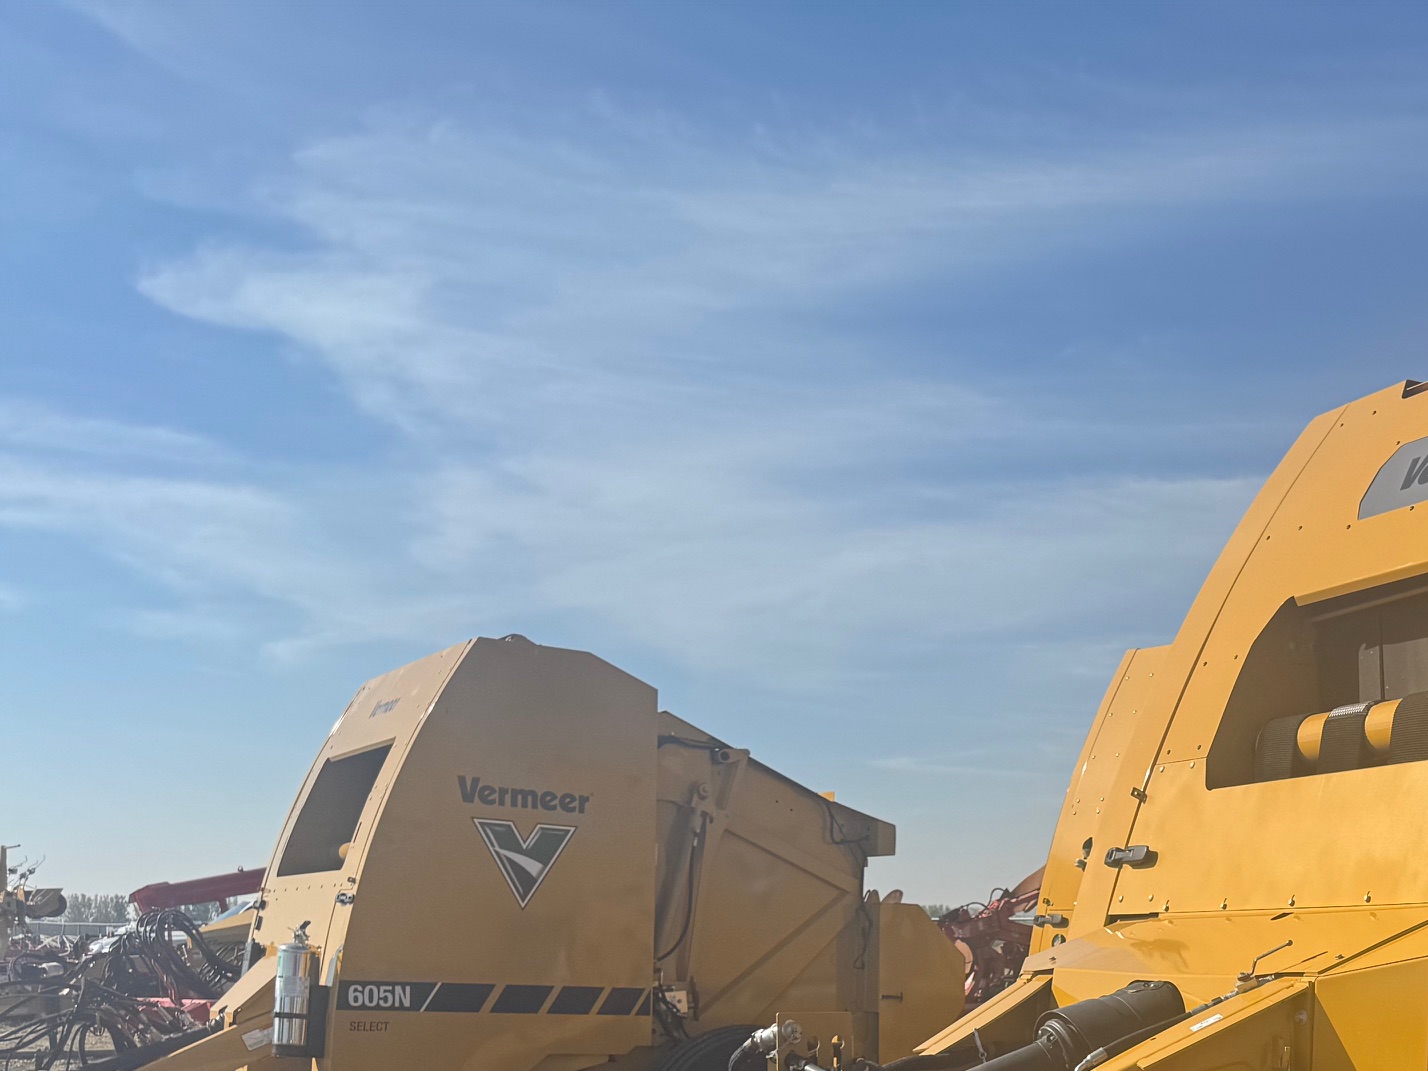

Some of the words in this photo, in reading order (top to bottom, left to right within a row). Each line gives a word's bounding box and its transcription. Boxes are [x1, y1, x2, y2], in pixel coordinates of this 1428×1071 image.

[457, 775, 590, 814] Vermeer
[348, 984, 411, 1008] 605N
[349, 1021, 390, 1032] SELECT
